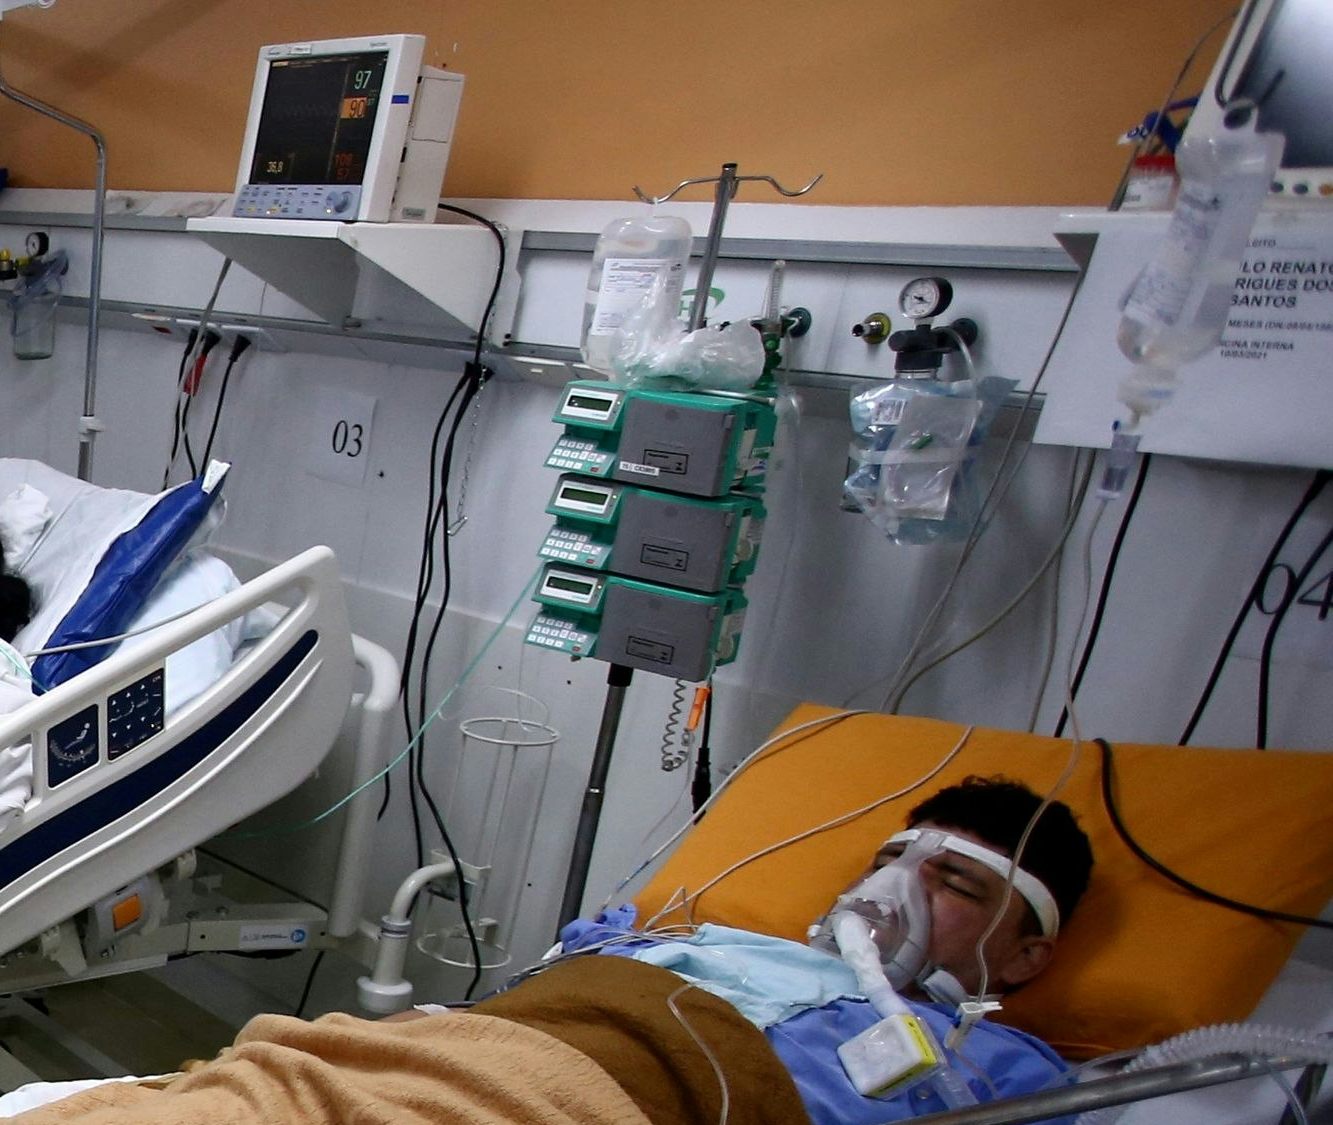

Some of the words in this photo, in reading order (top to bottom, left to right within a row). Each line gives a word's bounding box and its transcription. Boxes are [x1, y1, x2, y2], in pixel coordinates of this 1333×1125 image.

[354, 70, 372, 90] 97
[349, 99, 366, 118] 90
[1239, 260, 1266, 273] LO
[1229, 294, 1298, 308] SANTOS
[332, 420, 363, 457] 03
[1254, 563, 1333, 621] 04
